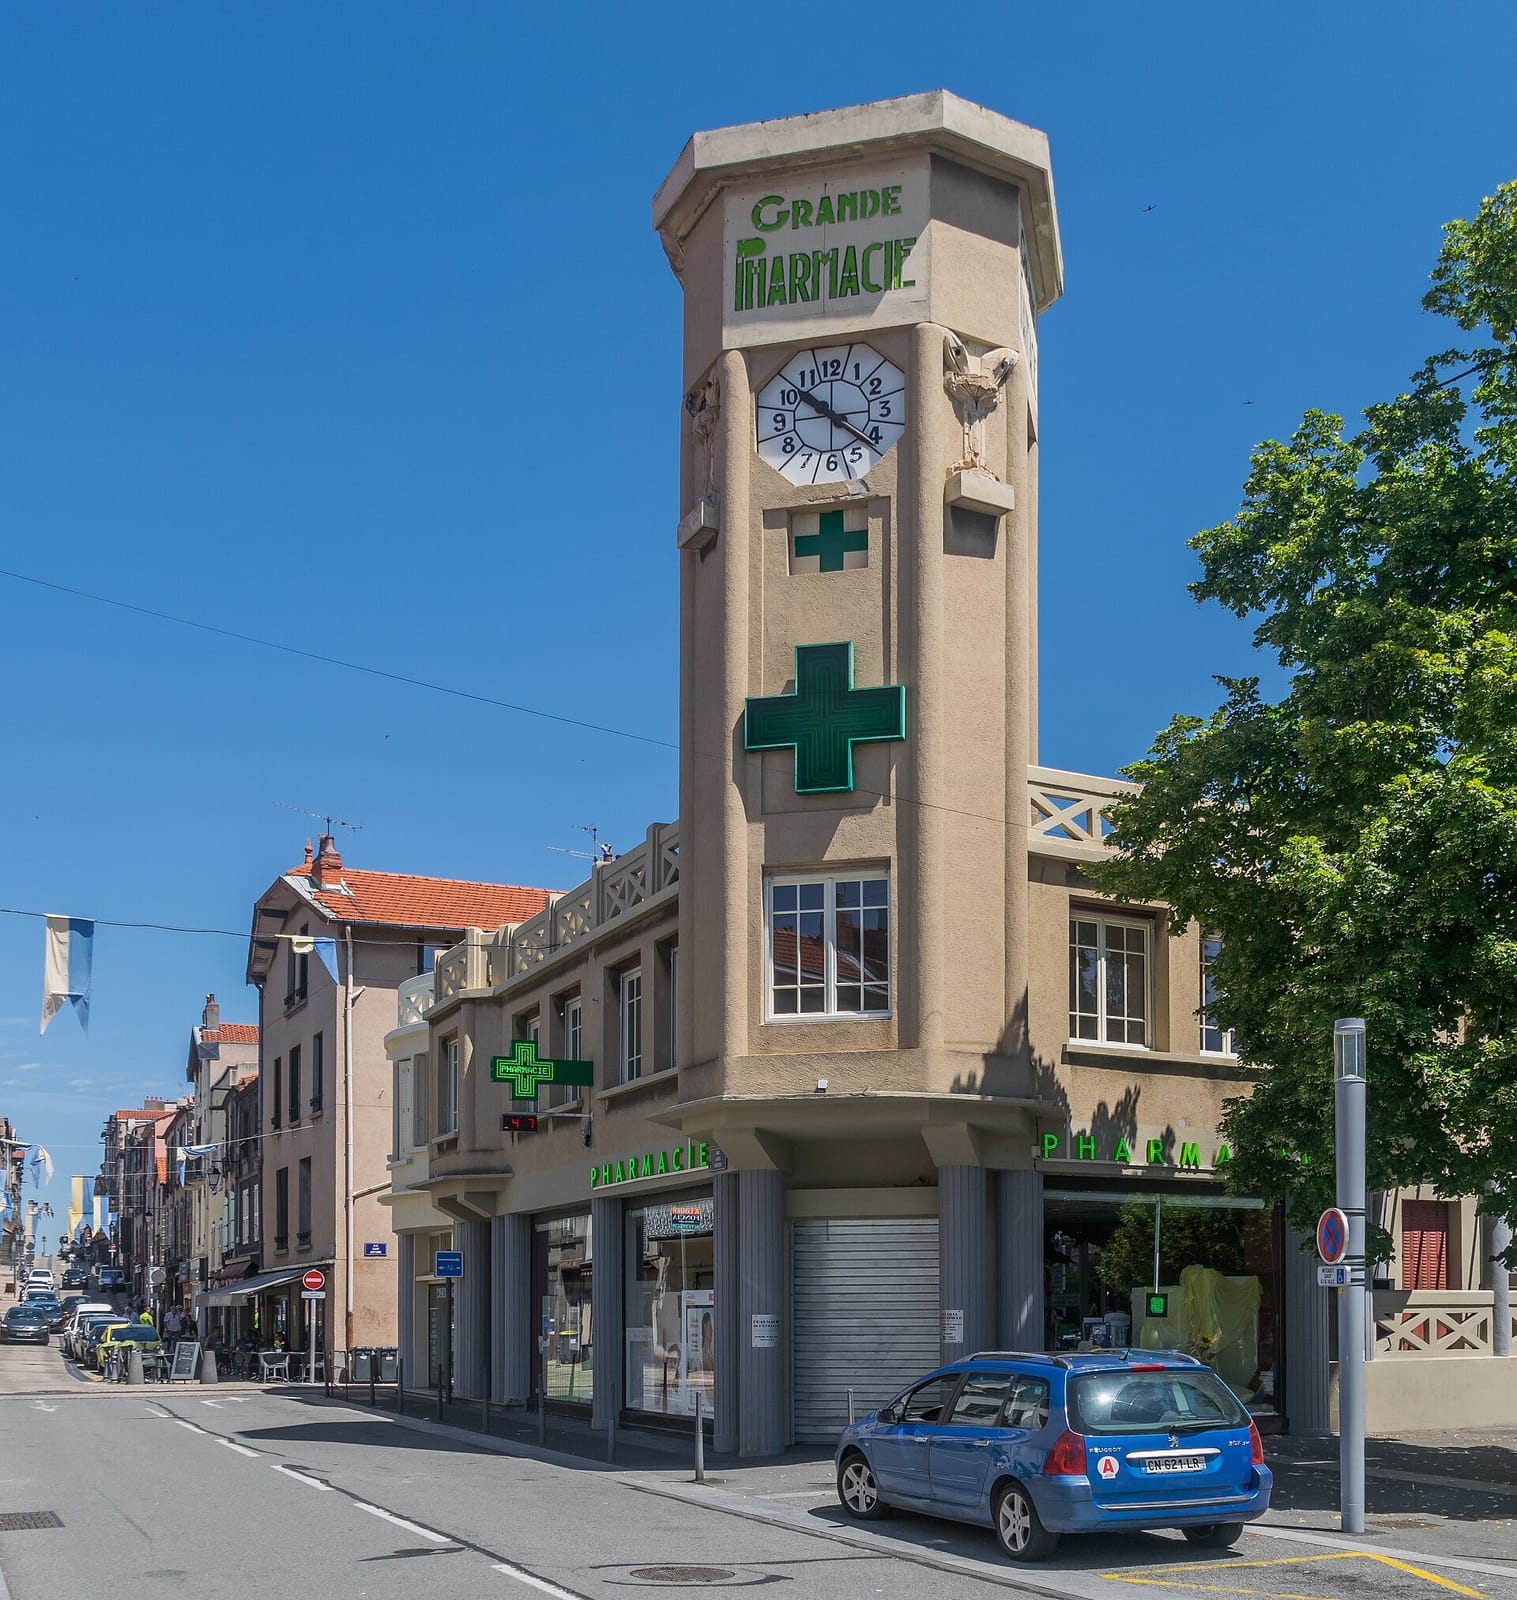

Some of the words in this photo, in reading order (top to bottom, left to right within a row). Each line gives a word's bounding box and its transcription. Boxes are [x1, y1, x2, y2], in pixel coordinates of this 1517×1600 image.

[751, 185, 902, 232] GRANDE
[735, 237, 917, 312] PHARMACIE
[821, 359, 841, 378] 12
[853, 363, 861, 381] 1
[798, 369, 816, 388] 11
[869, 377, 882, 395] 2
[780, 389, 798, 406] 10
[879, 400, 892, 418] 3
[773, 413, 787, 432] 9
[869, 426, 883, 445] 4
[781, 436, 795, 454] 8
[800, 453, 813, 469] 7
[826, 454, 838, 472] 6
[850, 447, 863, 464] 5
[501, 1065, 548, 1075] PHARMACIE
[590, 1142, 711, 1189] PHARMACIE
[1103, 1458, 1115, 1474] A
[1148, 1456, 1200, 1471] CN-621-LR
